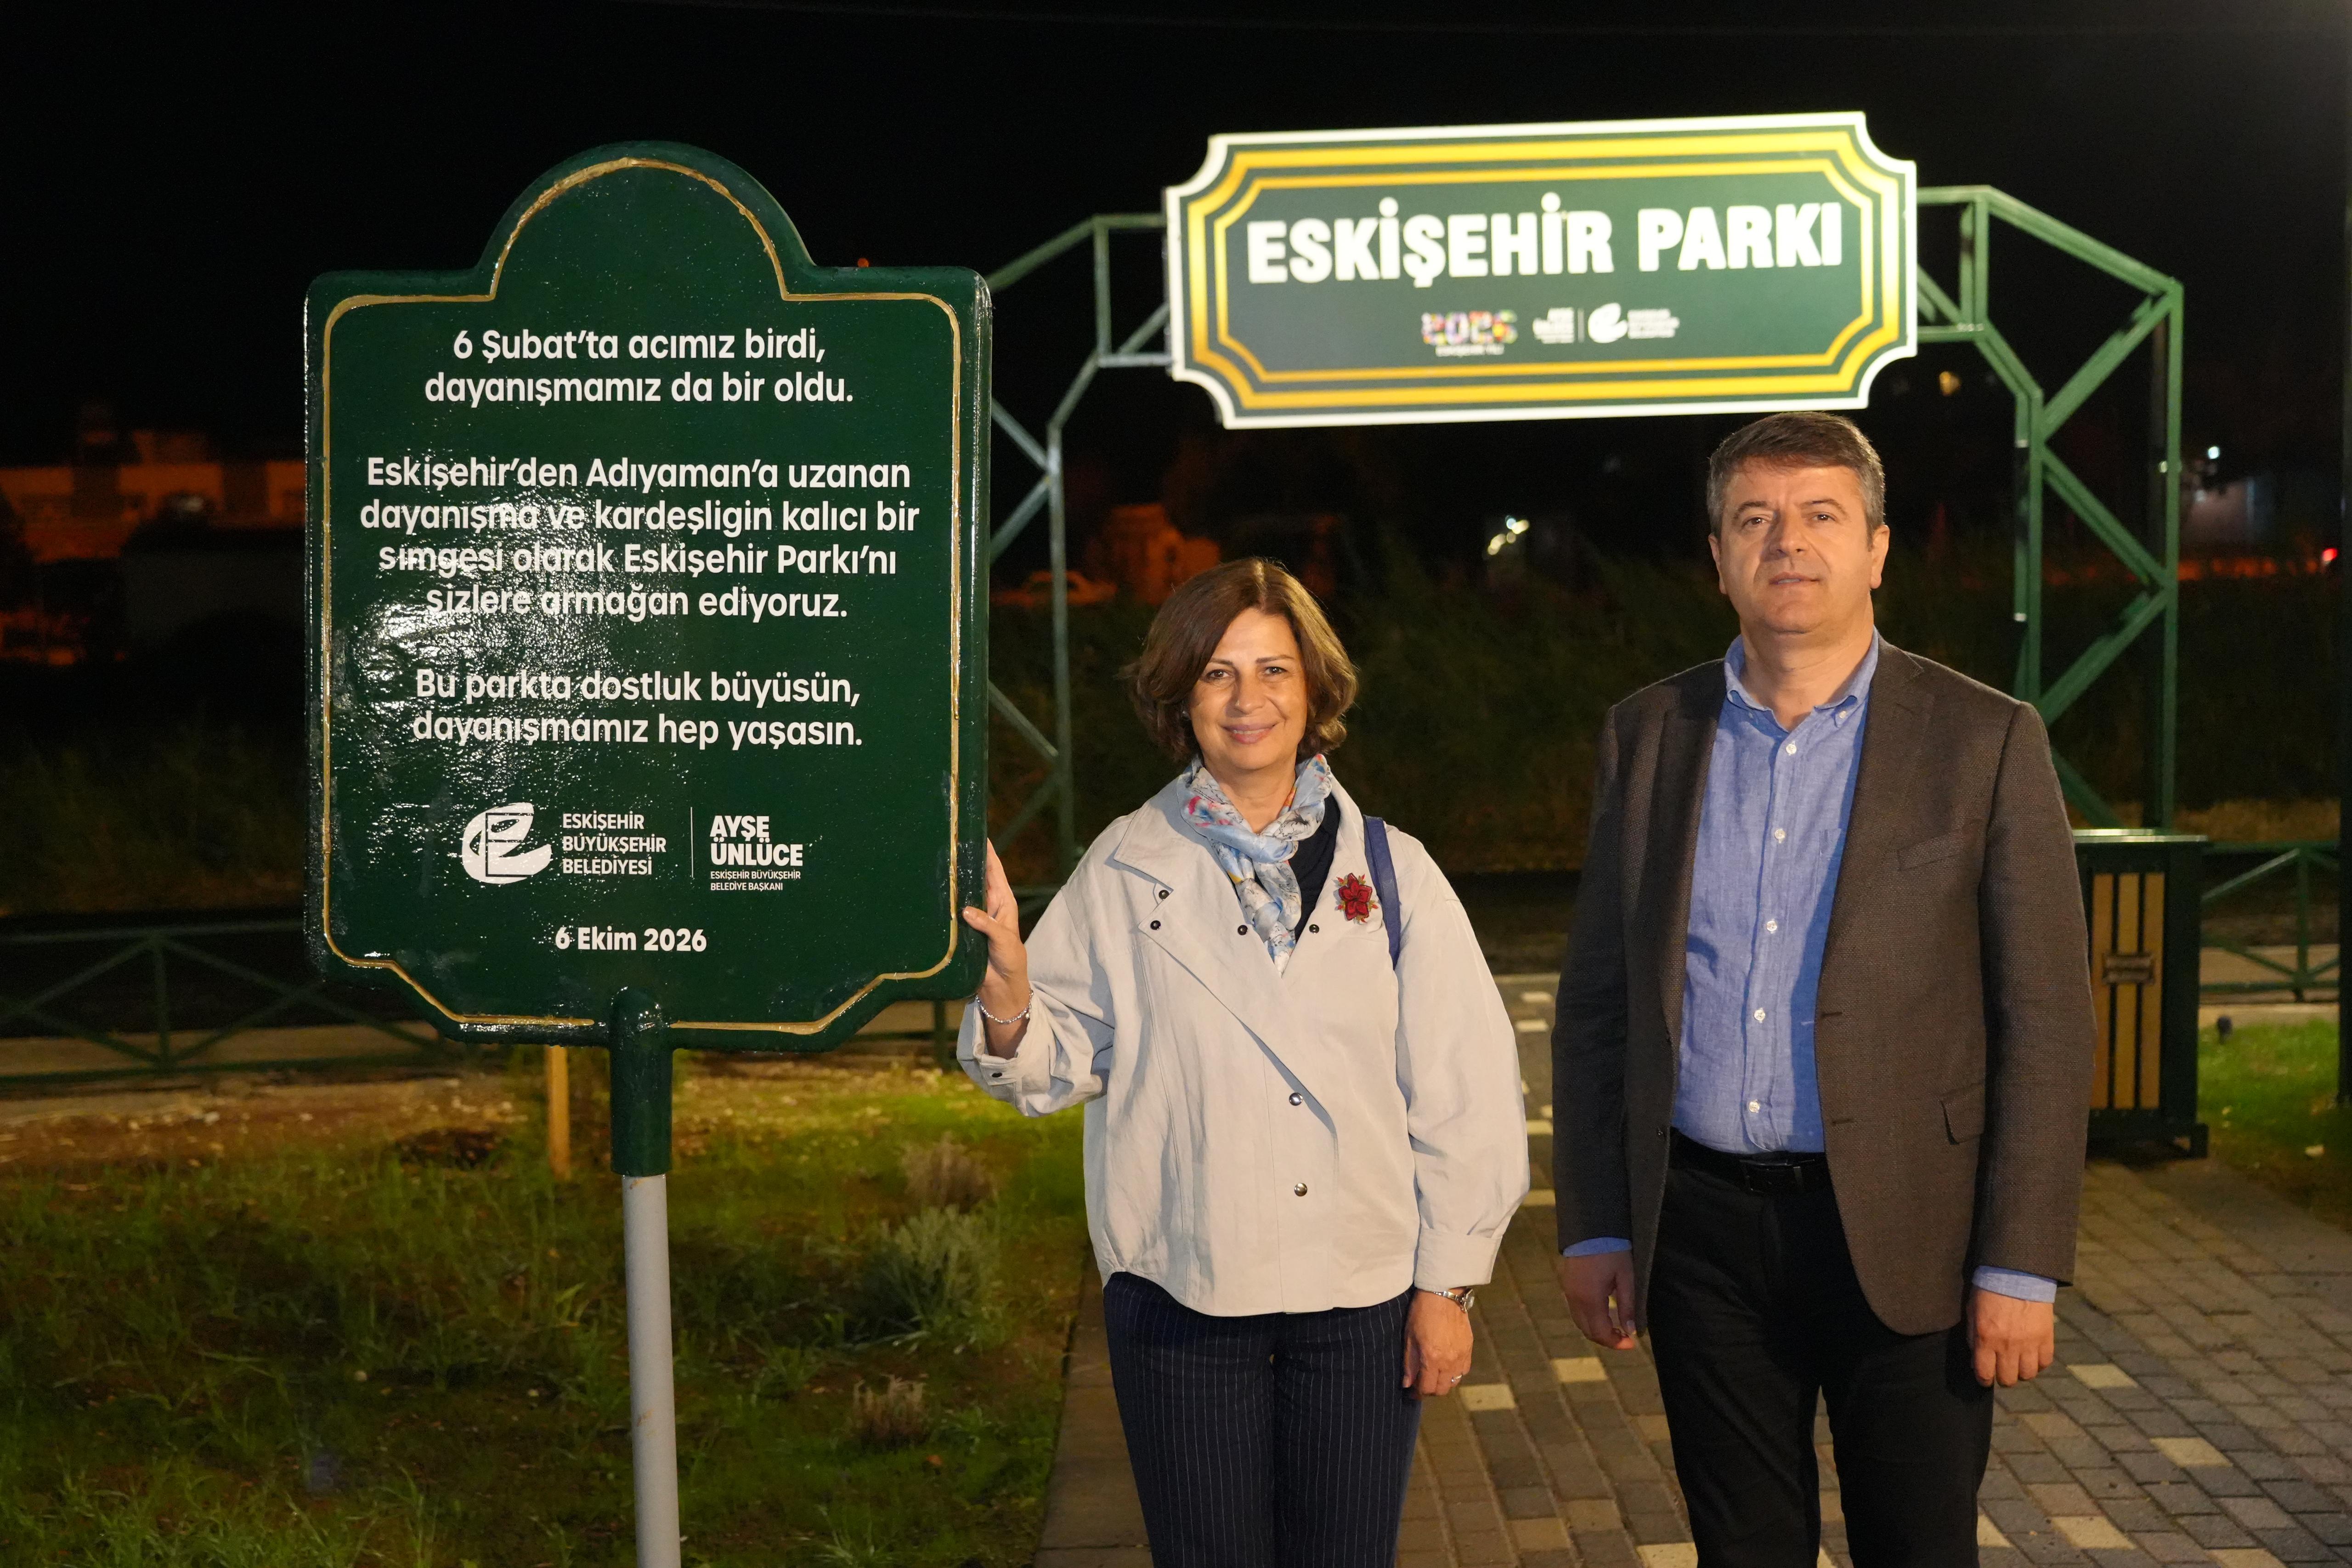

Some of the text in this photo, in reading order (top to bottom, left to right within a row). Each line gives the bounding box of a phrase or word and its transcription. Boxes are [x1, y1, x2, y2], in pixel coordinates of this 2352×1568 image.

[1247, 192, 1843, 288] ESKİŞEHİR PARKI
[454, 328, 824, 365] 6 Şubat'ta acımız birdi,
[426, 372, 852, 408] dayanışmamız da bir oldu.
[369, 457, 910, 493] Eskişehir'den Adıyaman'a uzanan
[361, 499, 919, 537] dayanışma ve kardeşligin kalıcı bir
[380, 542, 895, 579] simgesi olarak Eskişehir Parkı'nı
[427, 584, 846, 623] sizlere armağan ediyoruz.
[417, 669, 859, 708] Bu parkta dostluk büyüsün,
[413, 712, 861, 750] dayanışmamız hep yaşasın.
[563, 810, 645, 831] ESKİŞEHİR
[710, 815, 769, 841] AYŞE
[562, 833, 666, 854] BÜYÜKŞEHİR
[711, 837, 803, 866] ÜNLÜCE
[563, 857, 651, 875] BELEDİYESİ
[711, 870, 801, 880] ESKİŞEHİR BÜYÜKŞEHİR
[711, 882, 783, 891] BELEDİYE BAŞKANI
[556, 926, 706, 951] 6 Ekim 2026
